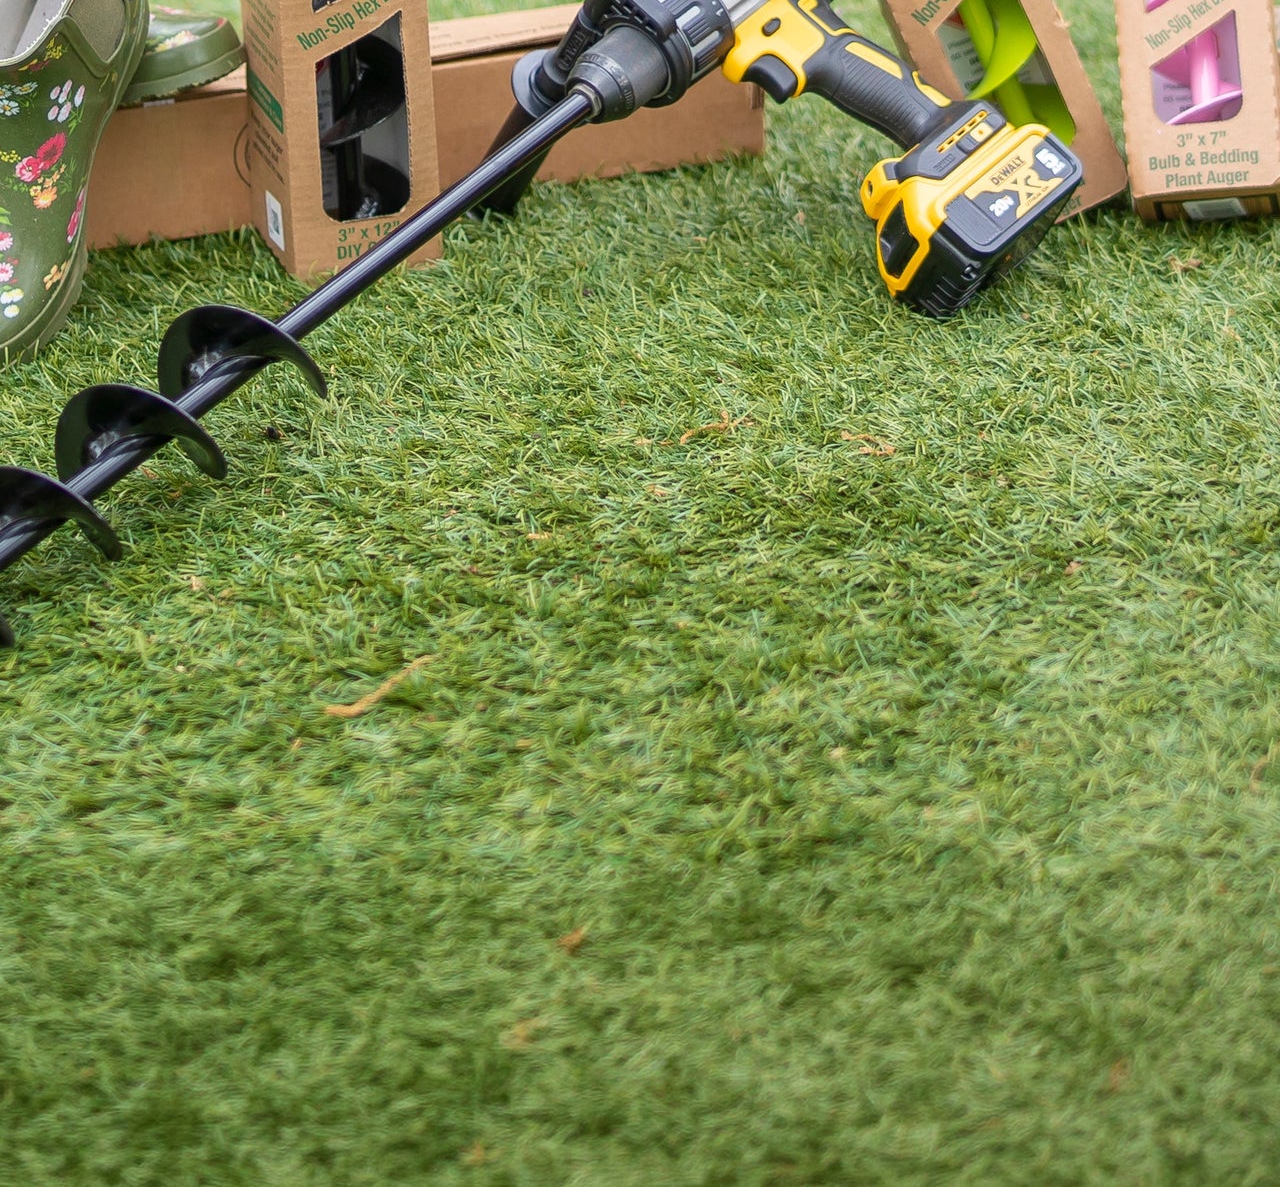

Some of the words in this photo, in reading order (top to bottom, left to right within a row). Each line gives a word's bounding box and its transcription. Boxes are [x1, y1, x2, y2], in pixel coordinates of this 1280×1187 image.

[297, 7, 357, 50] Non-Slip
[1144, 18, 1193, 50] Non-Slip
[1189, 1, 1210, 23] Hex
[1197, 134, 1206, 146] x
[1149, 155, 1181, 171] Bulb
[1184, 152, 1196, 166] &
[1200, 148, 1260, 165] Bedding
[1165, 172, 1202, 188] Plant
[1206, 169, 1250, 185] Auger
[361, 227, 369, 239] x
[337, 244, 362, 260] DIY
